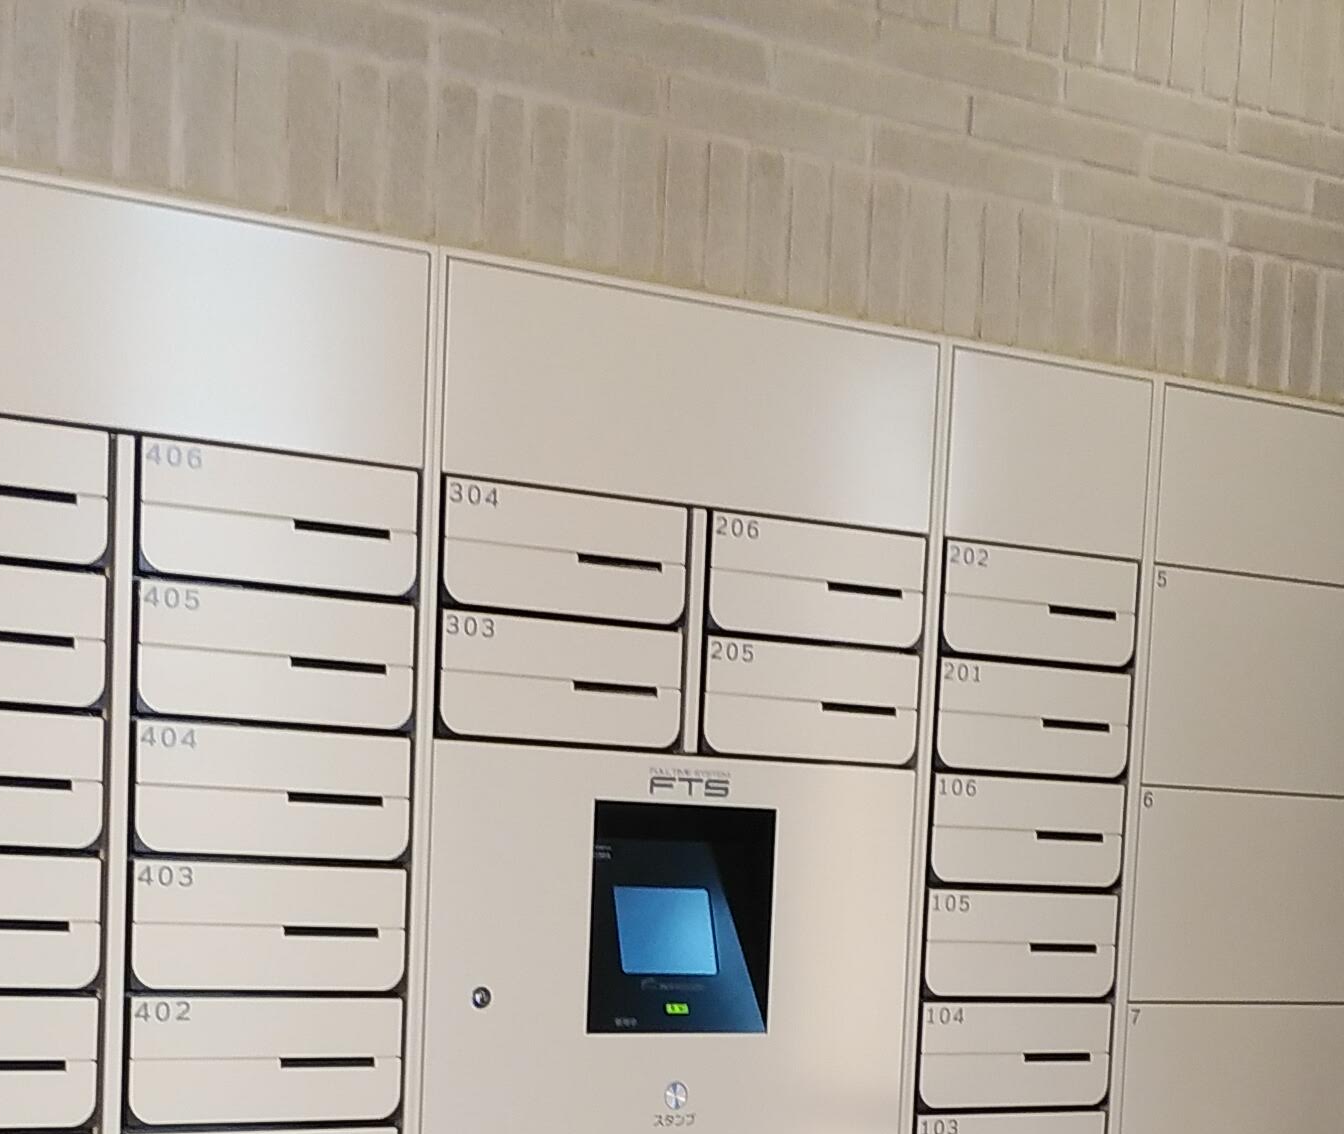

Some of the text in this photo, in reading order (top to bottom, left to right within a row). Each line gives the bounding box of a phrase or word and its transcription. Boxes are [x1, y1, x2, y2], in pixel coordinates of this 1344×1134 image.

[146, 443, 202, 469] 406
[449, 482, 498, 507] 304
[716, 516, 760, 539] 206
[950, 546, 989, 567] 202
[1157, 571, 1167, 588] 5
[144, 587, 199, 610] 405
[446, 614, 495, 638] 303
[711, 642, 754, 662] 205
[945, 662, 981, 683] 201
[140, 727, 197, 749] 404
[649, 776, 730, 798] FTS
[939, 779, 976, 797] 106
[1143, 791, 1153, 808] 6
[138, 866, 193, 887] 403
[933, 895, 970, 913] 105
[135, 1001, 191, 1021] 402
[927, 1007, 965, 1025] 104
[1131, 1009, 1140, 1024] 7
